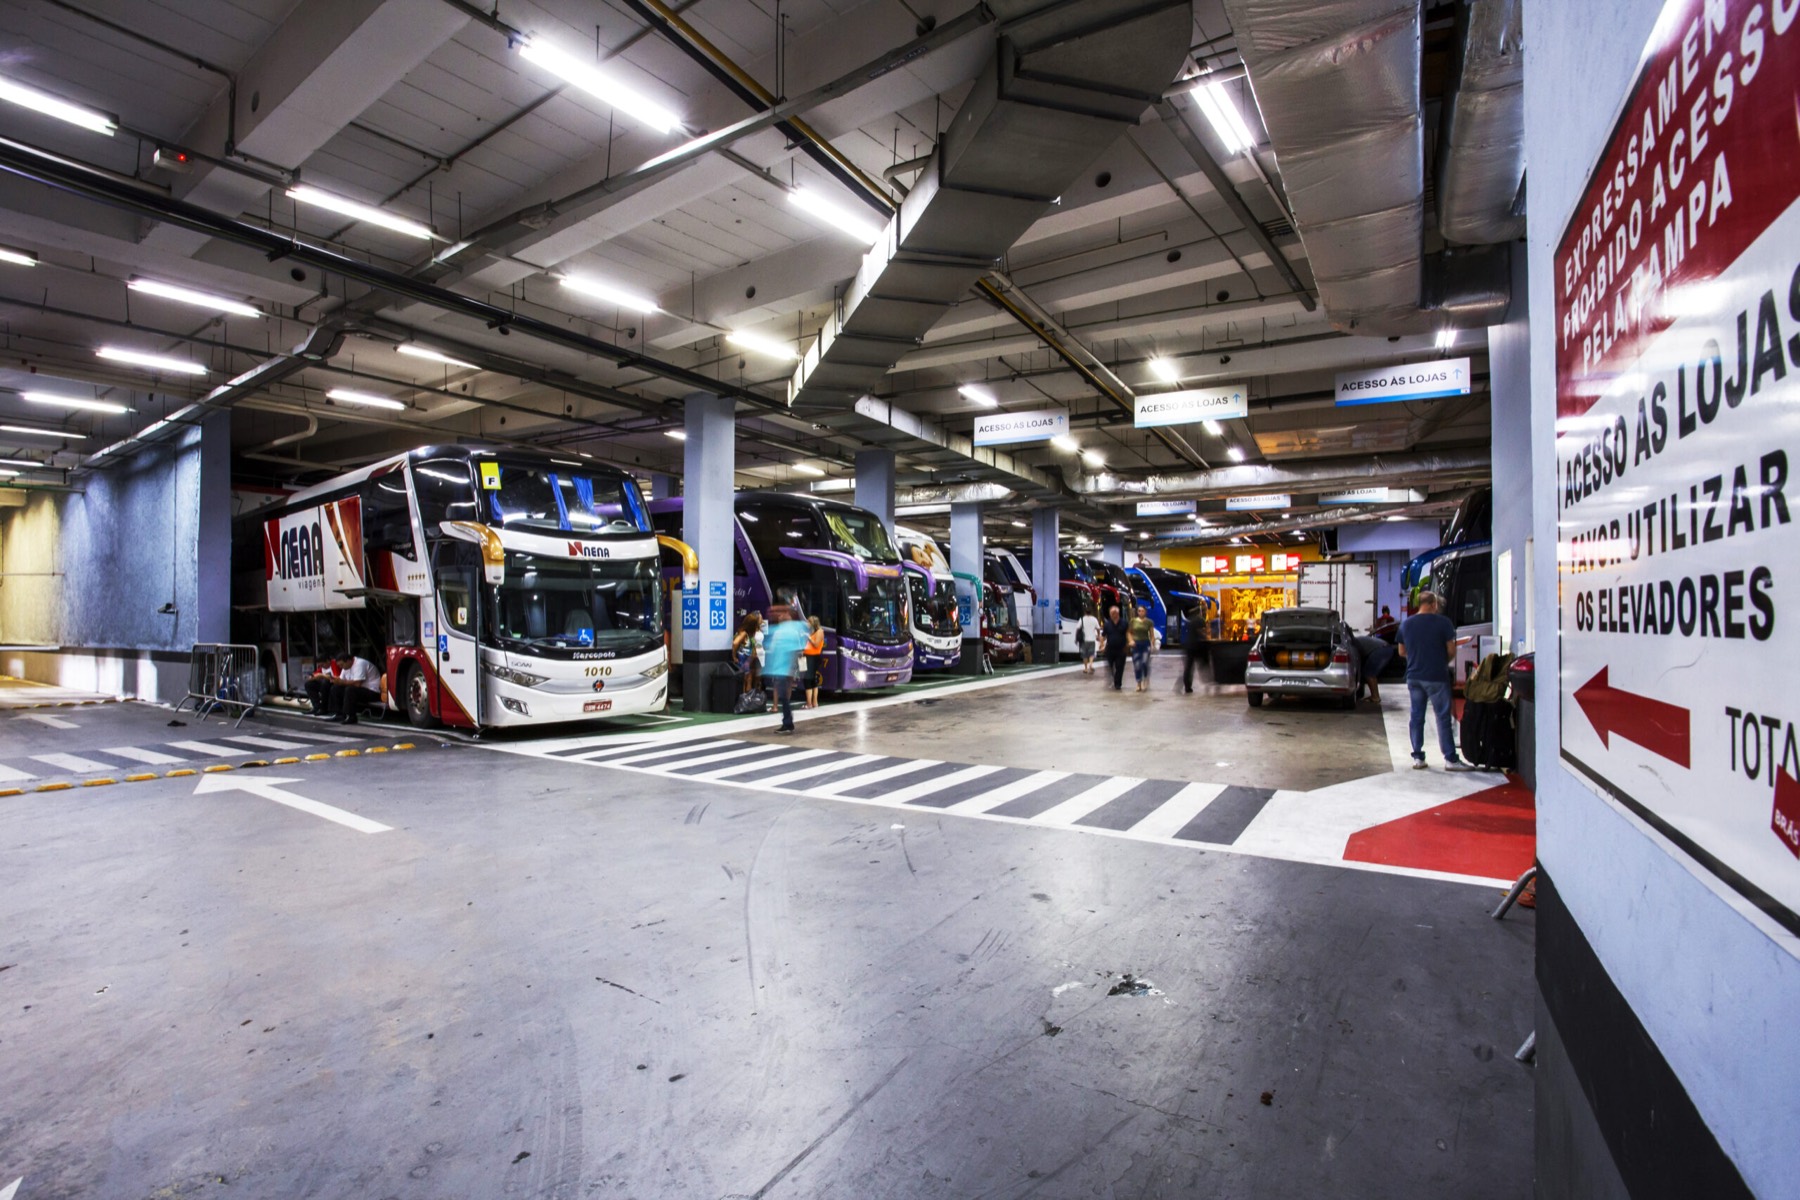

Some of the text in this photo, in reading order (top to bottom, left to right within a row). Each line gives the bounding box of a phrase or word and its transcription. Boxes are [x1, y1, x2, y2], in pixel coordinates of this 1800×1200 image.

[1583, 151, 1733, 377] PELA RAMPA
[1563, 198, 1642, 351] PROIBIDO
[1341, 372, 1447, 392] ACESSO ÀS LOJAS
[1140, 403, 1179, 414] ACESSO
[1197, 396, 1229, 407] LOJAS
[978, 423, 1012, 433] ACESSO
[1026, 418, 1054, 428] LOJAS
[1565, 415, 1628, 510] ACESSO
[488, 477, 496, 486] F
[1571, 449, 1792, 575] FAVOR UTILIZAR
[281, 521, 324, 580] NENA
[584, 546, 610, 558] NENA
[298, 577, 326, 592] viagens
[1576, 566, 1775, 641] OS ELEVADORES
[683, 610, 699, 626] B3
[711, 610, 725, 626] B3
[584, 666, 612, 677] 1010
